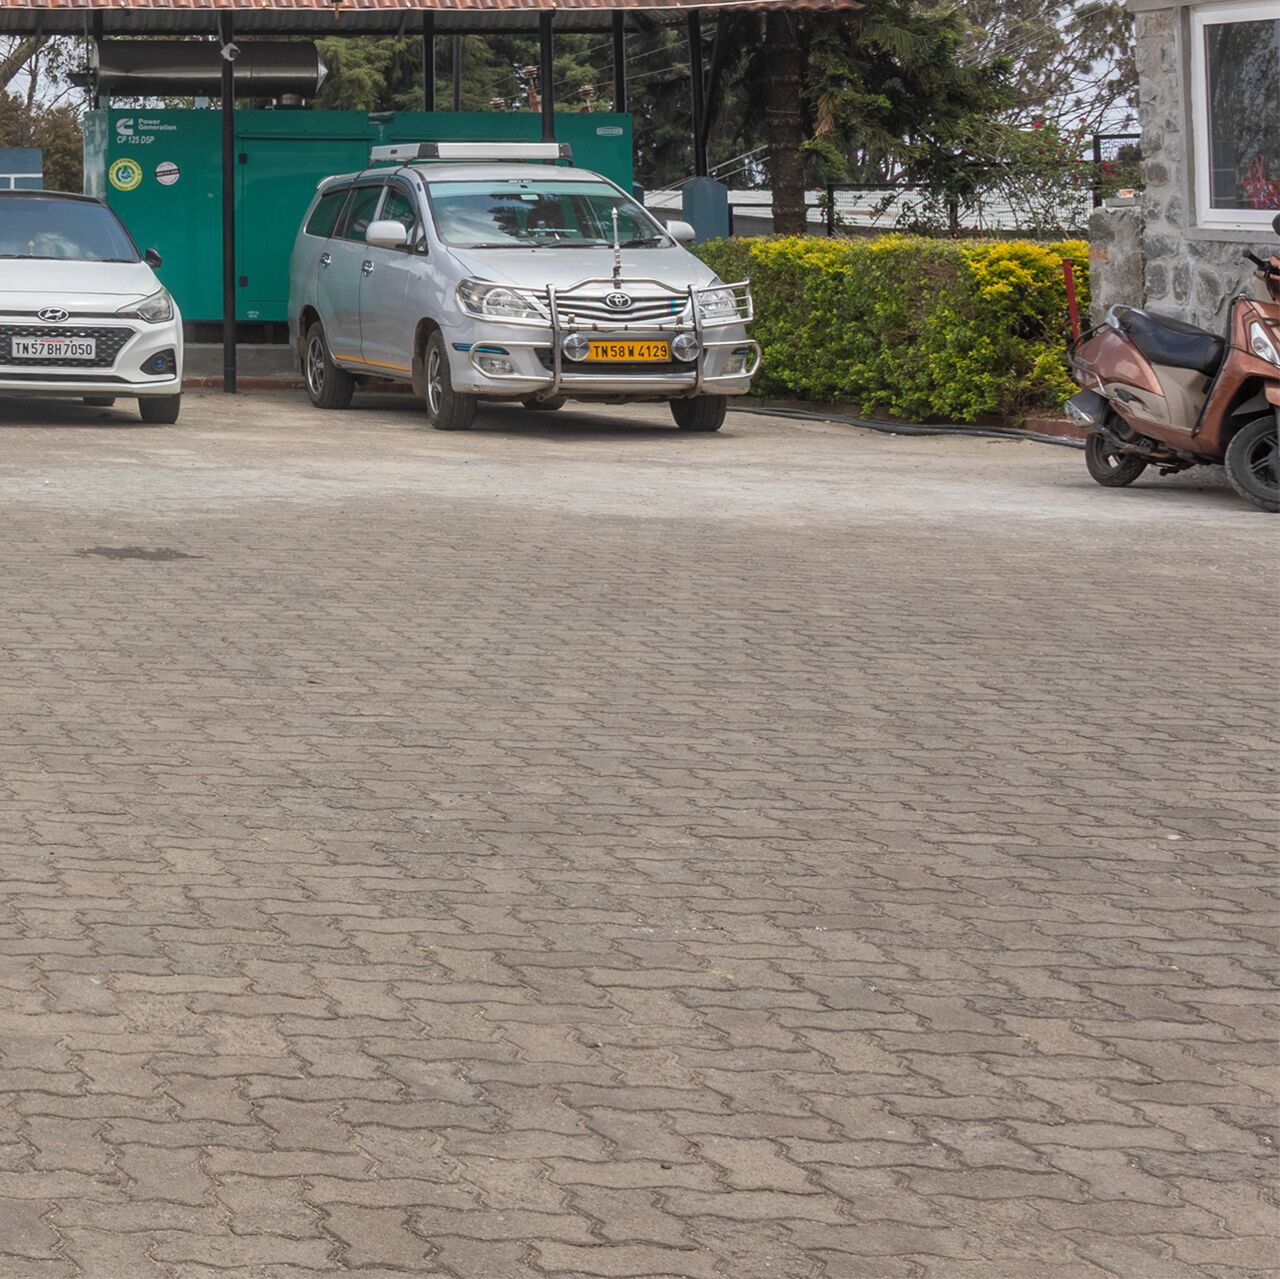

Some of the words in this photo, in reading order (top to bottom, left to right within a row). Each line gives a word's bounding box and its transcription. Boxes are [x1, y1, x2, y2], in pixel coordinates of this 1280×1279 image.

[116, 135, 127, 144] CP
[128, 135, 140, 144] 125
[638, 345, 667, 357] 4129
